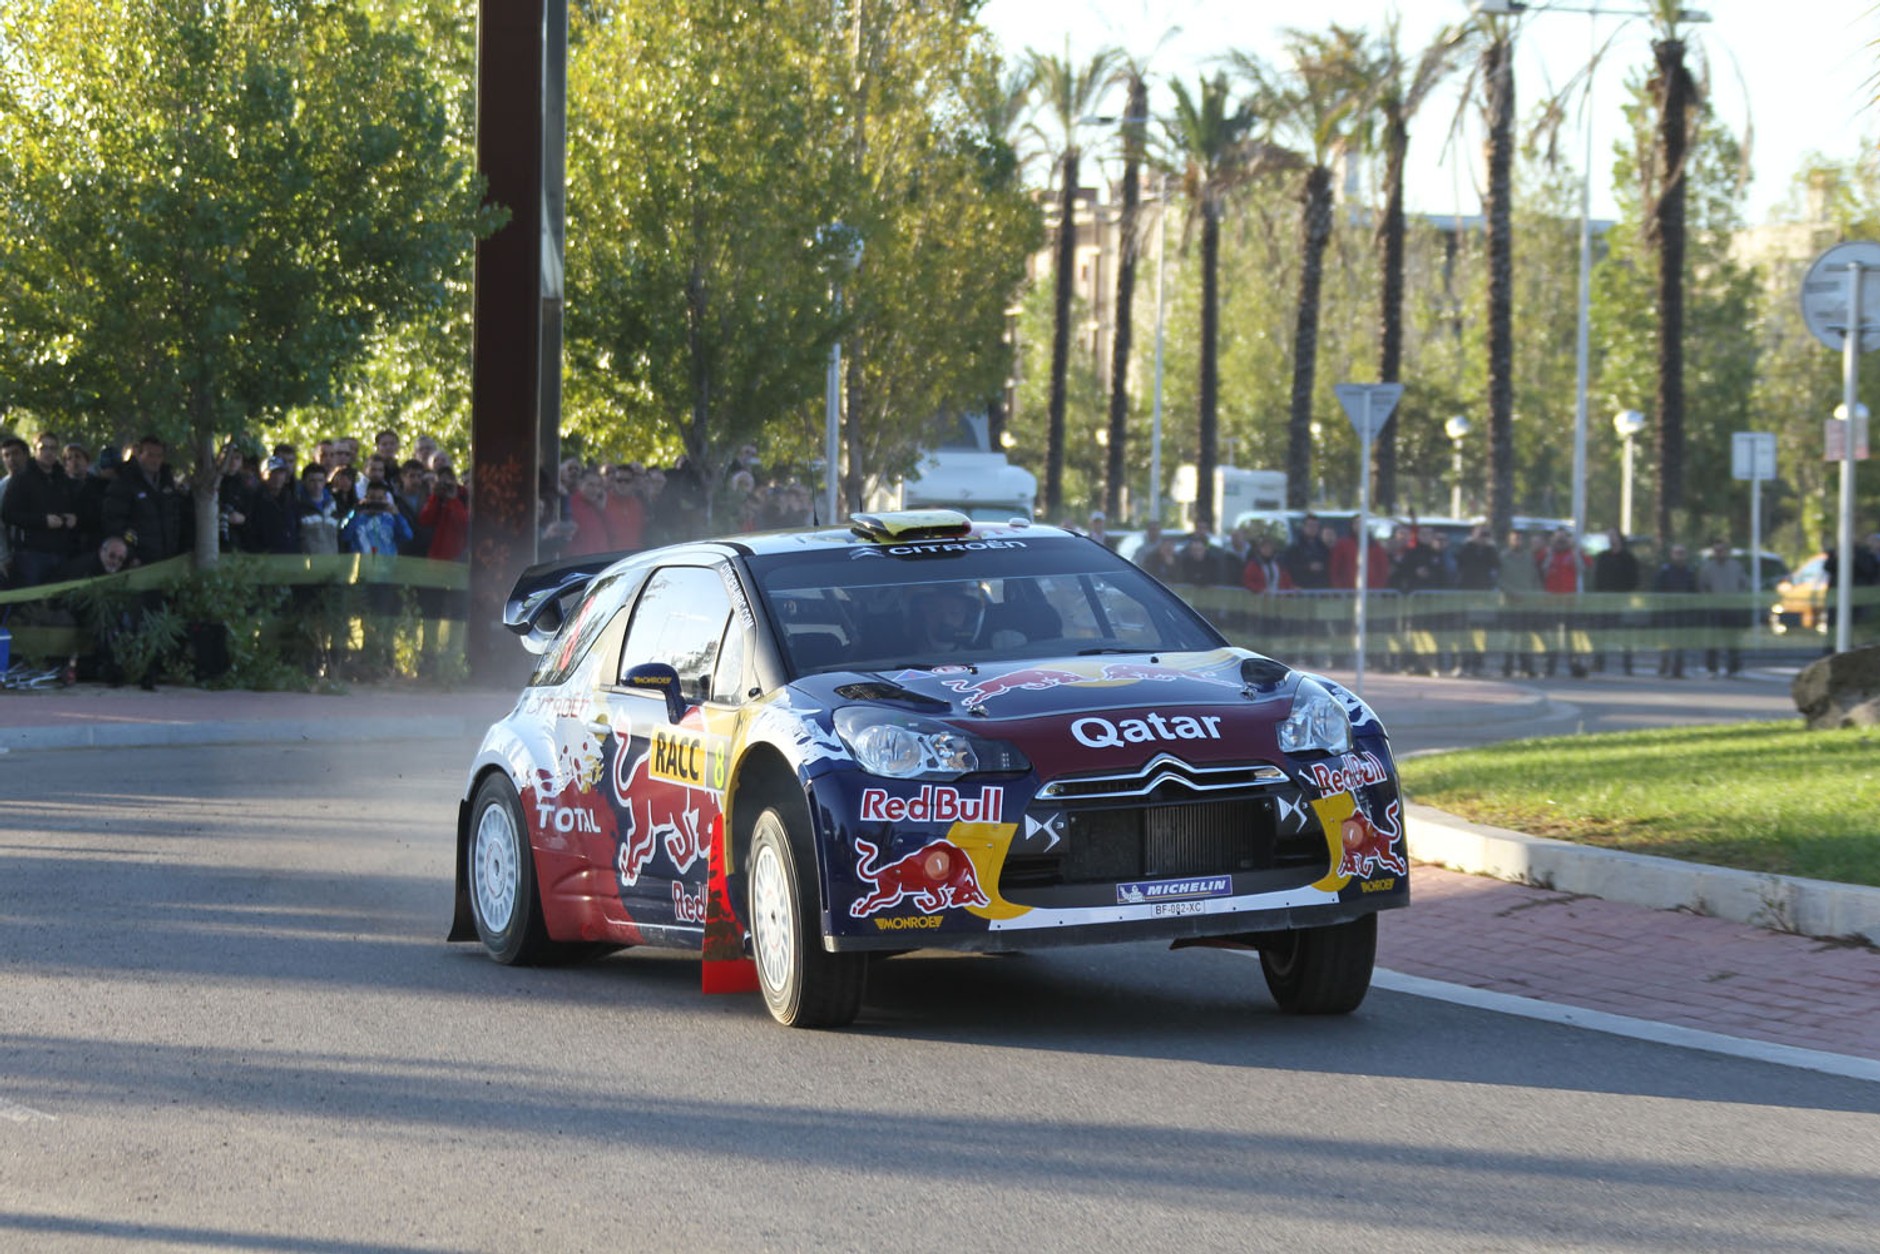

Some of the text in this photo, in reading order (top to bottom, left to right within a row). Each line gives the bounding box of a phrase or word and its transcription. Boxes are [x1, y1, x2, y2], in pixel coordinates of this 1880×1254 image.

[1071, 712, 1221, 748] Qatar
[655, 731, 701, 781] RACC
[713, 740, 725, 789] 8
[536, 803, 602, 833] TOTAL
[1147, 880, 1226, 895] MICHELIN
[880, 916, 939, 930] MONROE
